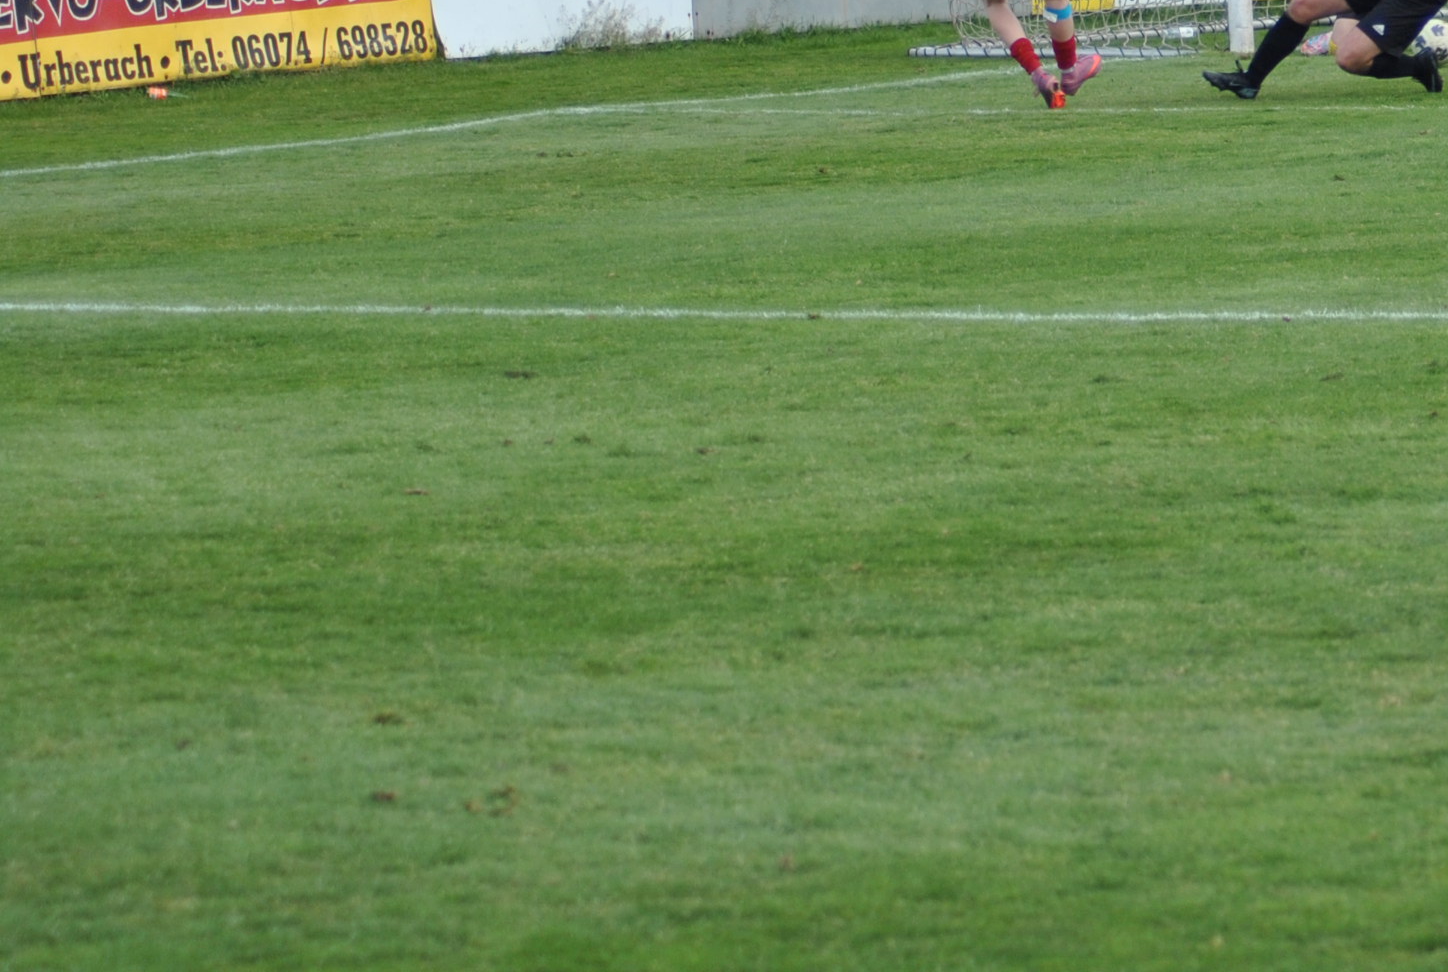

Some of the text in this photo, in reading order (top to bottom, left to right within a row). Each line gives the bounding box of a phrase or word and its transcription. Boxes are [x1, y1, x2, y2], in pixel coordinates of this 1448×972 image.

[18, 19, 428, 91] Urberach Tel: 06074 / 698528
